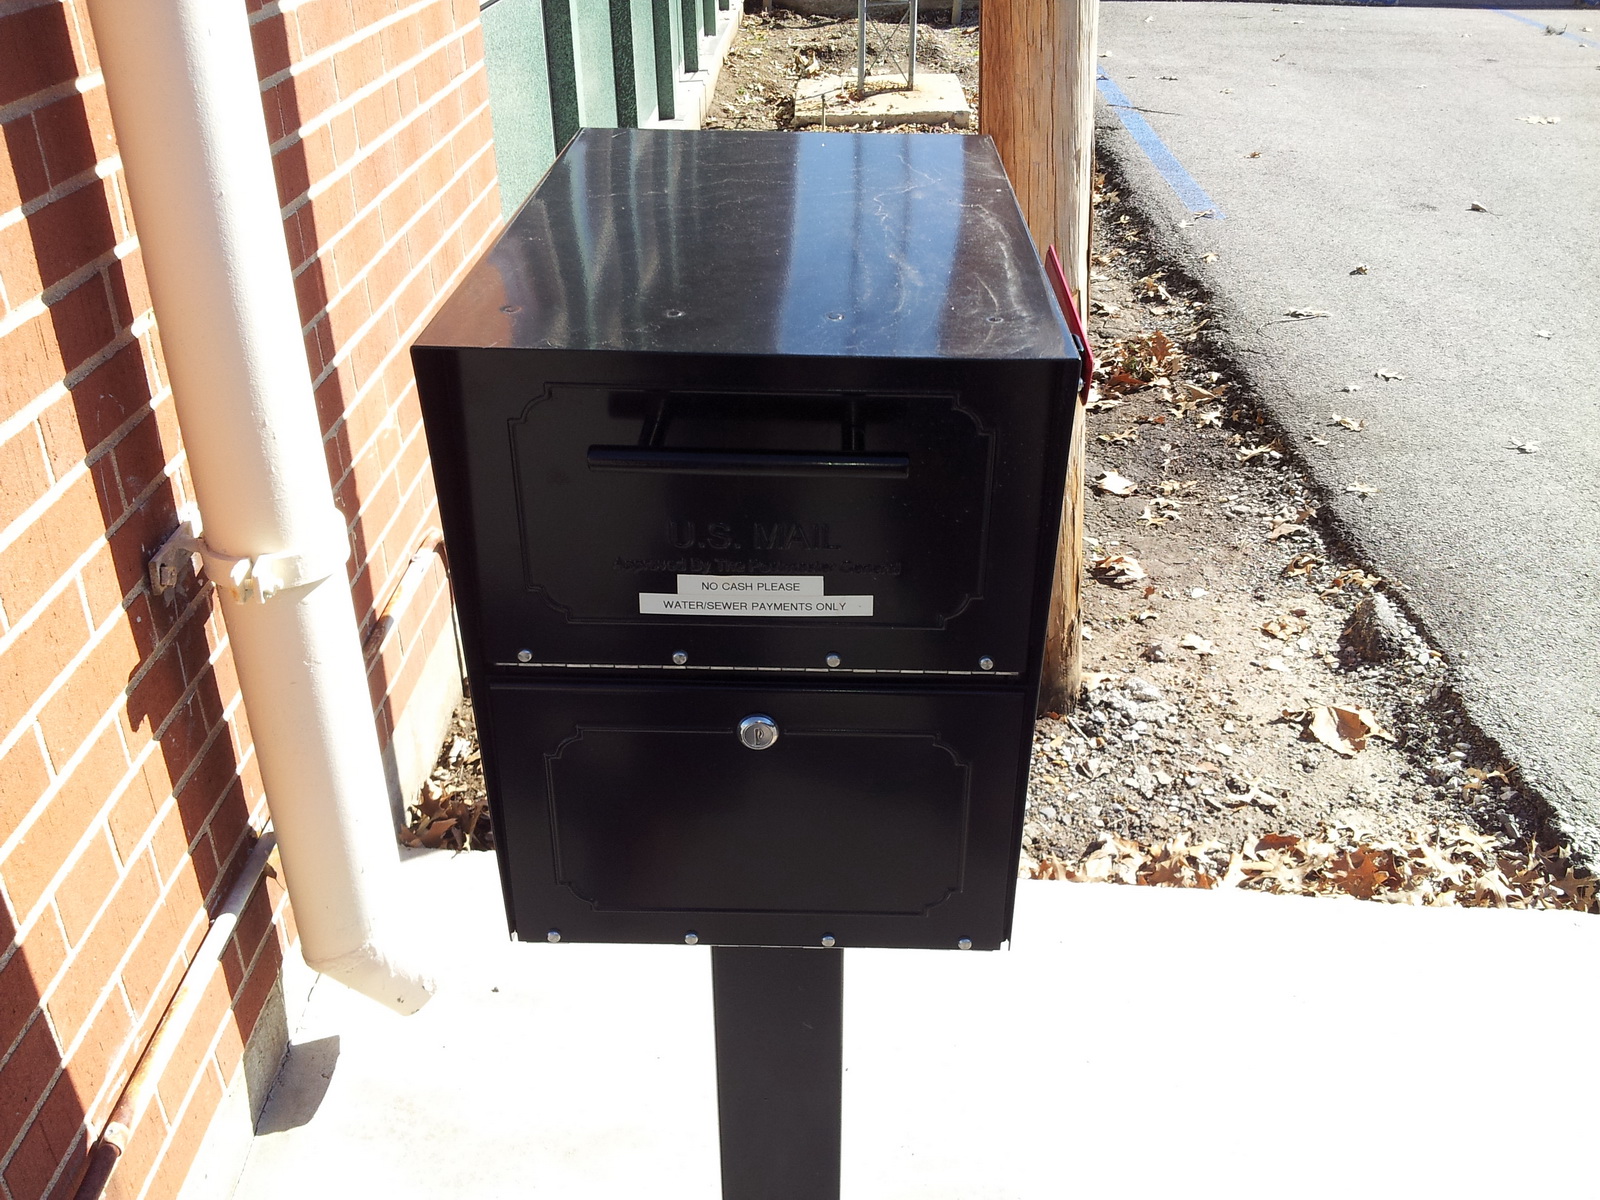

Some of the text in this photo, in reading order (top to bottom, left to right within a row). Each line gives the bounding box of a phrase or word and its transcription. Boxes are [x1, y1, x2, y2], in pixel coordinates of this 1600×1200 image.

[667, 519, 842, 551] U.S. MAIL
[690, 557, 711, 575] By
[715, 557, 746, 573] The
[701, 581, 801, 592] NO CASH PLEASE
[663, 600, 846, 612] WATER/SEWER PAYMENTS ONLY
